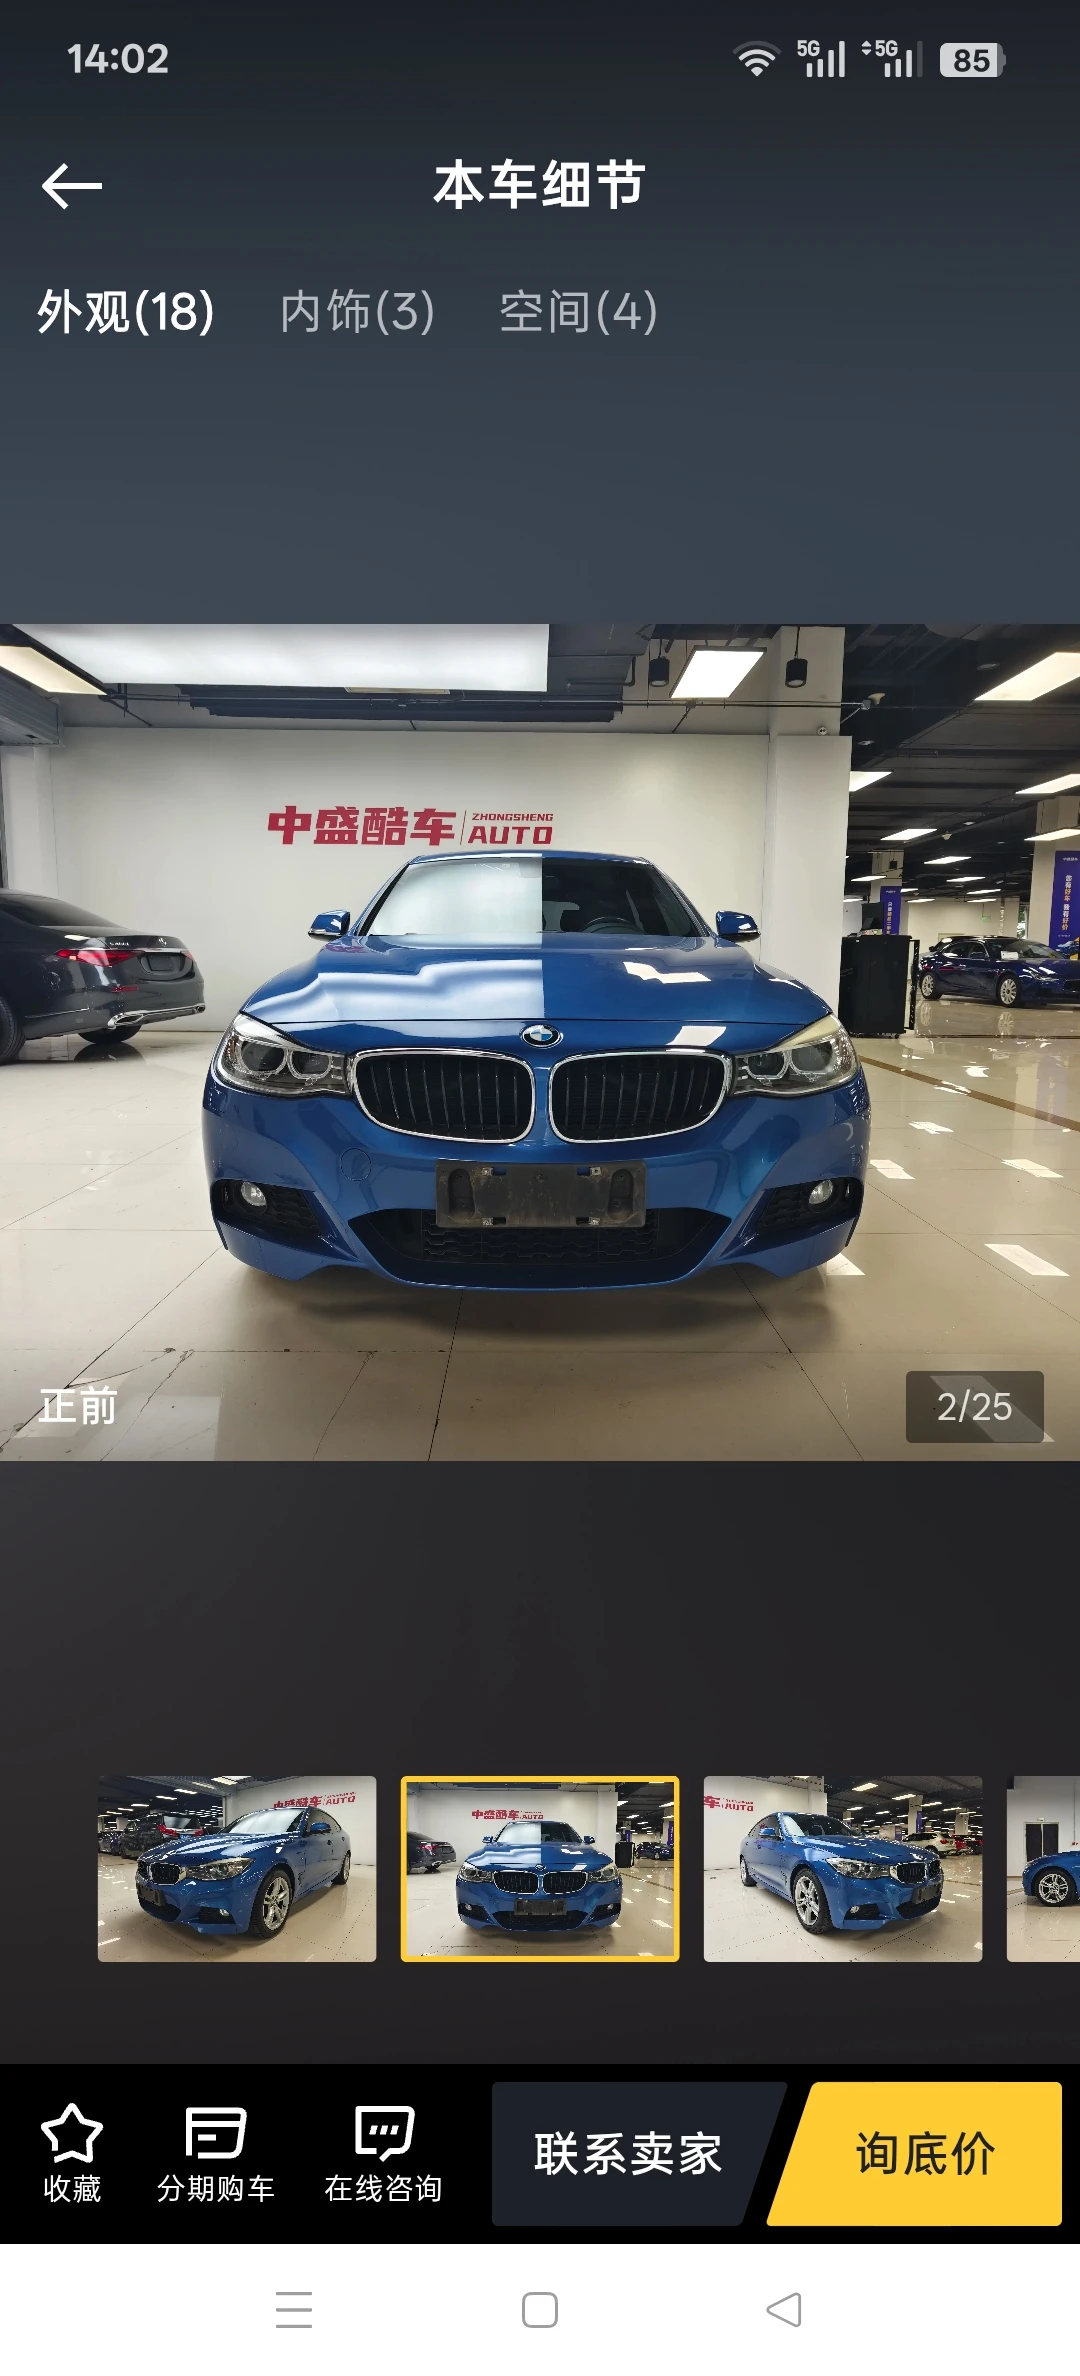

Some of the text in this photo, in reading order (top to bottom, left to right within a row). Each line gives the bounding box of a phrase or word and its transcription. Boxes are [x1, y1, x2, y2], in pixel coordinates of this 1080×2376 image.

[67, 43, 169, 74] 14:02
[796, 39, 821, 57] 5G
[875, 39, 899, 57] 5G
[953, 48, 991, 73] 85
[432, 158, 646, 210] 本车细节
[36, 288, 214, 337] 外观(18)
[280, 288, 434, 337] 内饰(3)
[499, 288, 657, 337] 空间(4)
[267, 805, 457, 846] 中盛酷车
[471, 812, 554, 822] ZHONGSHENG
[467, 826, 553, 846] AUTO
[325, 1796, 356, 1806] AUTO
[471, 1809, 520, 1821] 中盛酷车
[533, 2130, 723, 2176] 联系卖家
[855, 2130, 996, 2176] 询底价
[43, 2173, 102, 2204] 收藏
[156, 2173, 275, 2203] 分期购车
[324, 2173, 442, 2203] 在线咨询
